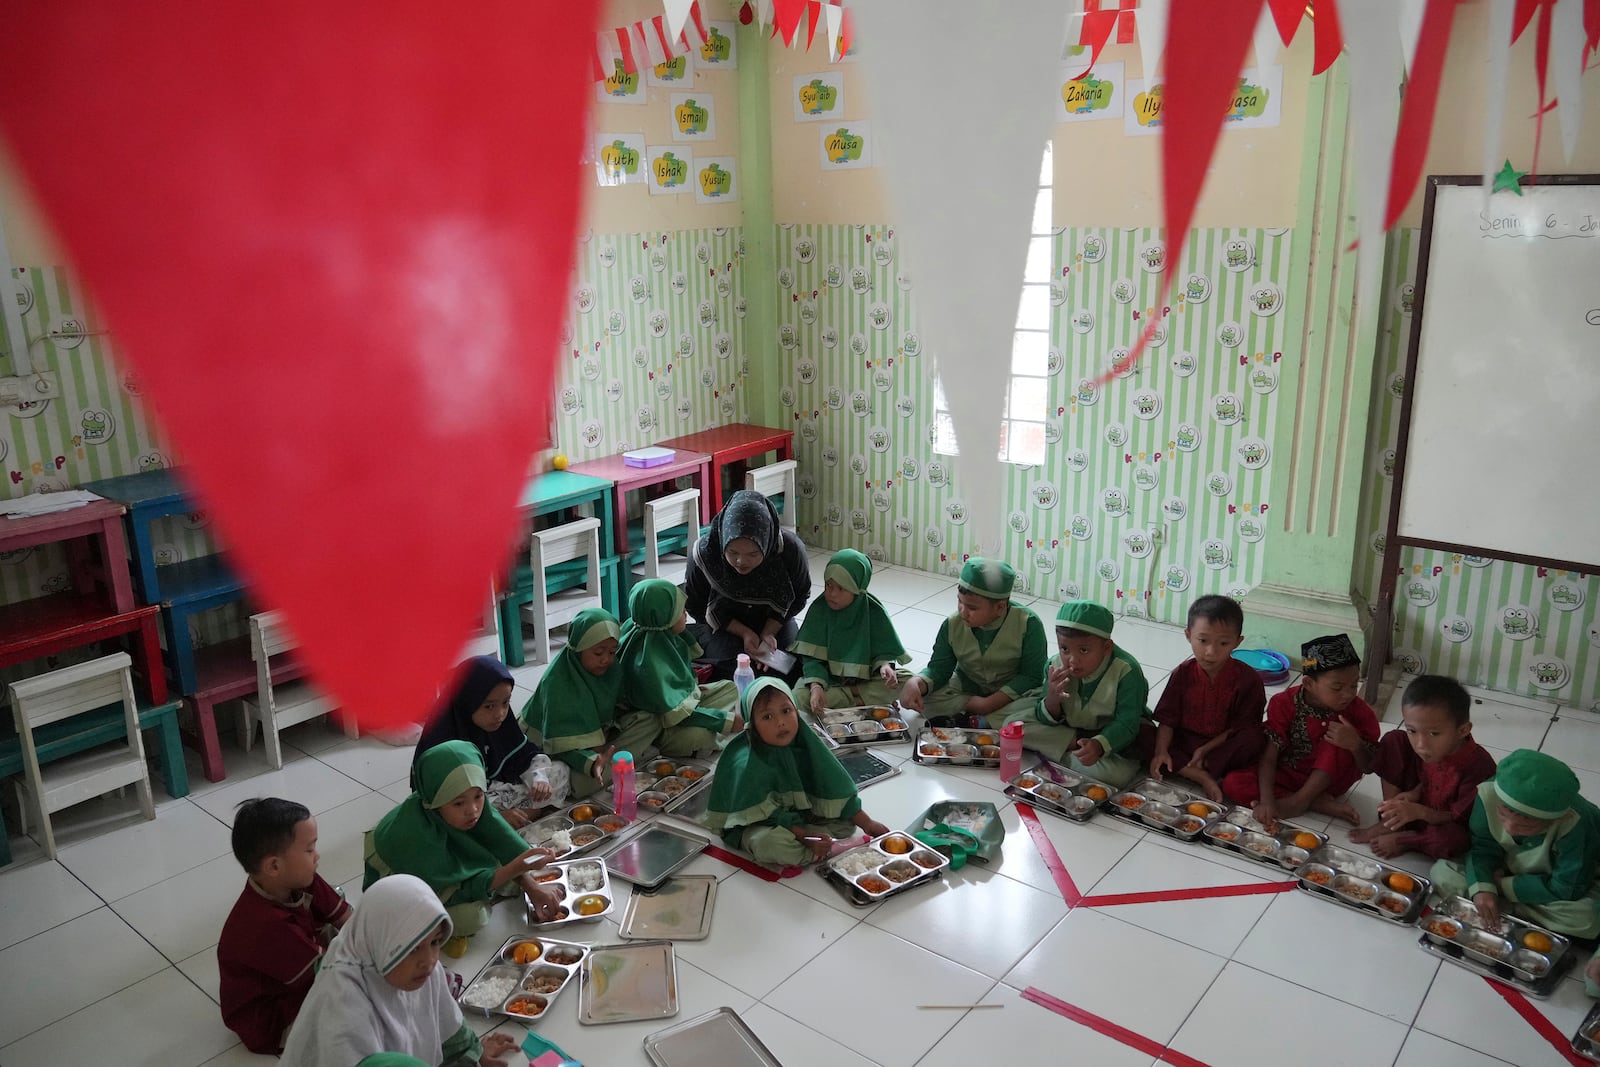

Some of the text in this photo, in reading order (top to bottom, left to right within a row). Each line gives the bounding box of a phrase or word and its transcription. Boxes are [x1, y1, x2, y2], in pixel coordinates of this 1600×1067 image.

[1066, 84, 1102, 103] Zakaria
[679, 109, 704, 124] Ismail
[829, 139, 857, 151] Musa
[606, 153, 634, 166] Luth
[658, 163, 682, 177] Ishak
[703, 173, 726, 187] Yusuf
[1545, 213, 1557, 229] 6
[1578, 214, 1600, 232] Ja
